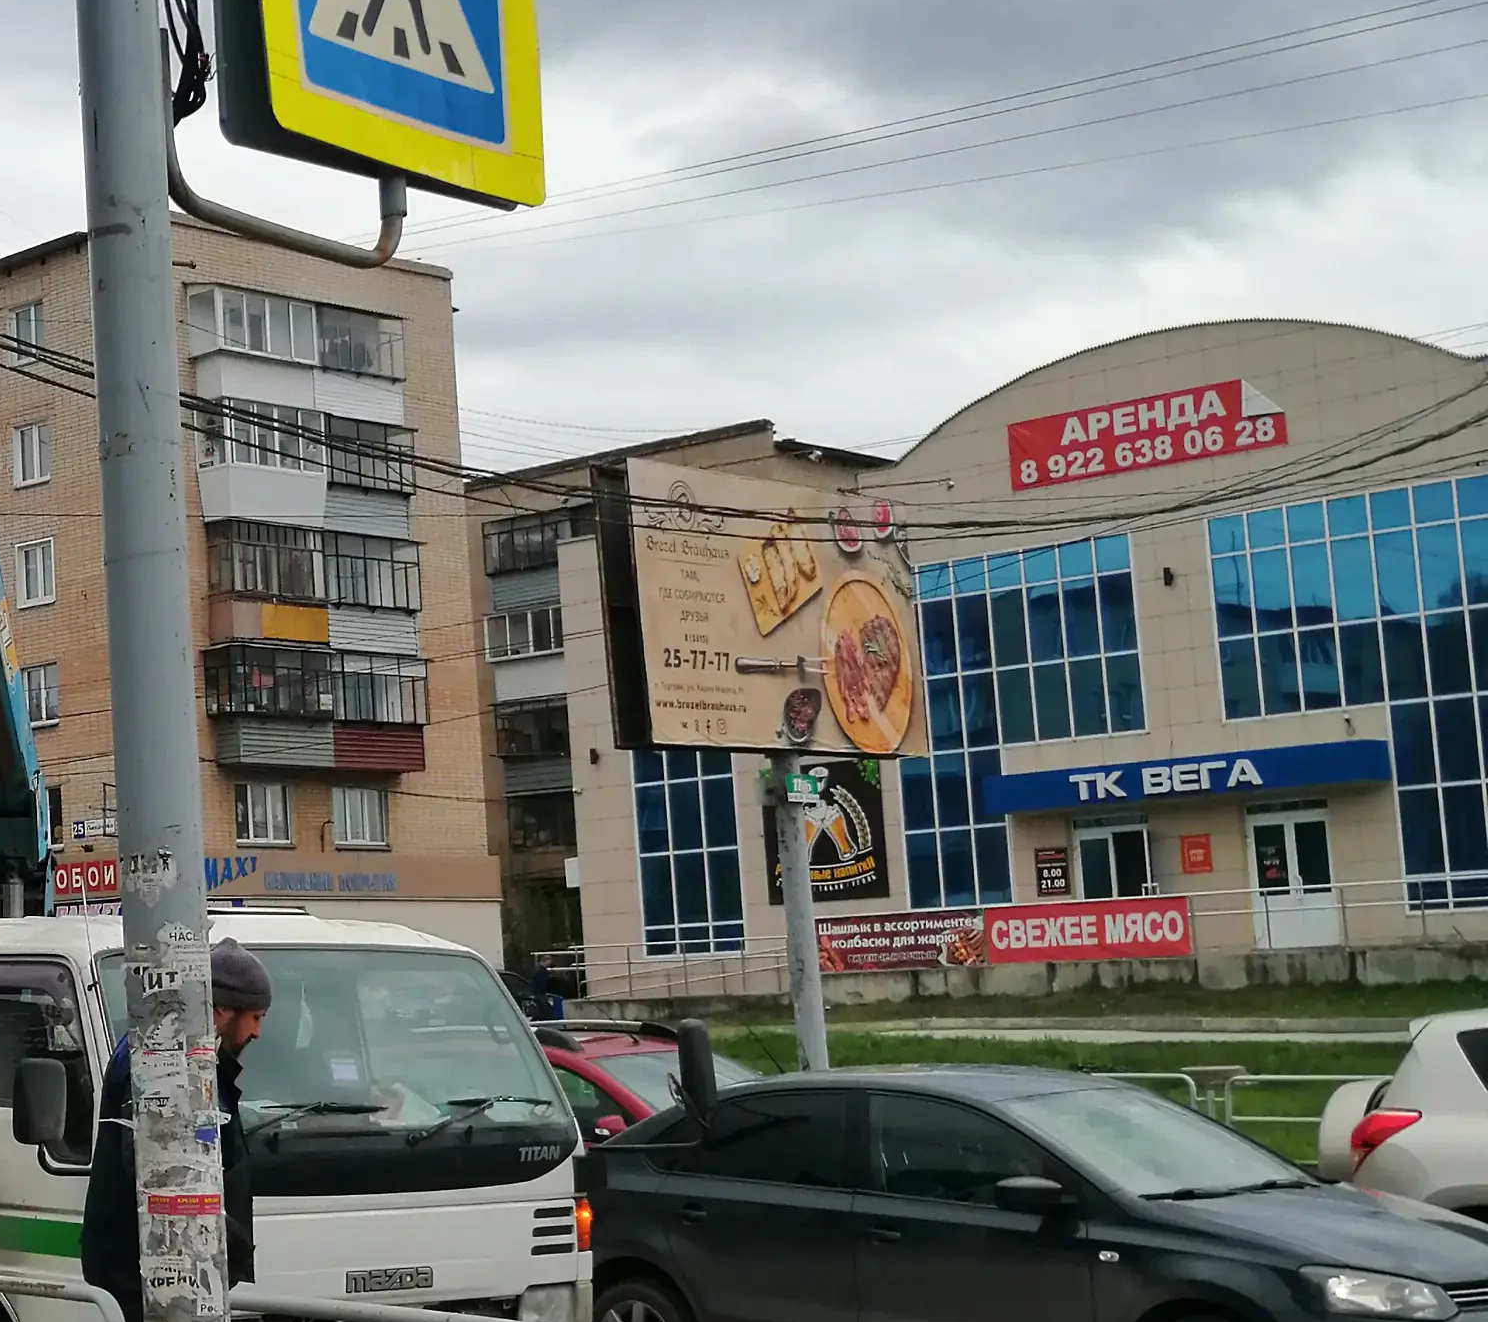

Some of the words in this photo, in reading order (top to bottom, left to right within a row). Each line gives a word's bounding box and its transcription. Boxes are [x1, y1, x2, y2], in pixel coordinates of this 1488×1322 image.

[1061, 390, 1227, 446] АРЕНДА
[1020, 459, 1038, 484] 8
[1047, 448, 1104, 478] 922
[1114, 435, 1173, 467] 638
[1183, 426, 1223, 454] 06
[1234, 417, 1275, 446] 28
[663, 648, 730, 672] 25-77-77
[1069, 769, 1127, 801] ТК
[1141, 758, 1263, 795] ВЕГА
[73, 823, 84, 835] 25
[56, 864, 116, 890] ОБОИ
[1041, 879, 1065, 888] 21.00
[1043, 868, 1062, 878] 8.00
[818, 921, 871, 935] Шашлык
[874, 923, 881, 932] в
[884, 917, 973, 935] ассортименте
[991, 913, 1098, 950] СВЕЖЕЕ
[1104, 909, 1184, 945] МЯСО
[831, 934, 890, 950] колбаски
[892, 934, 915, 948] для
[917, 932, 959, 949] жарки
[519, 1144, 560, 1161] TITAN
